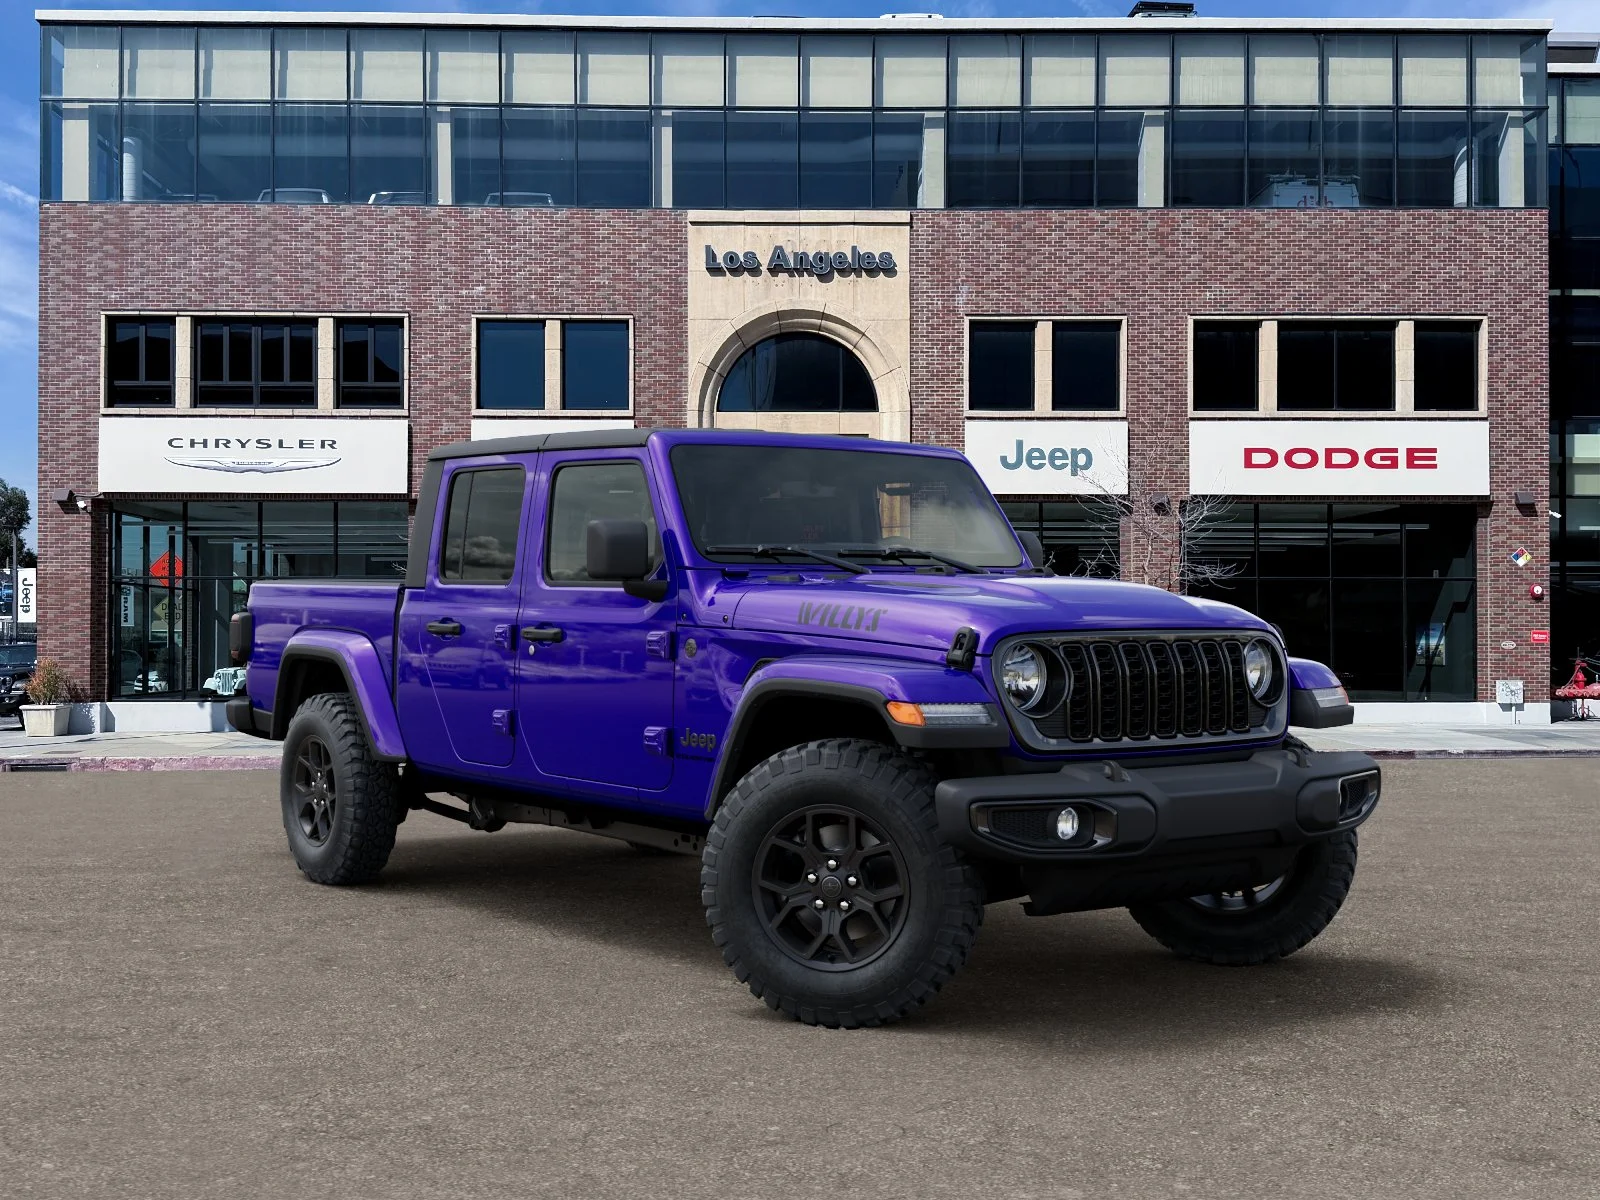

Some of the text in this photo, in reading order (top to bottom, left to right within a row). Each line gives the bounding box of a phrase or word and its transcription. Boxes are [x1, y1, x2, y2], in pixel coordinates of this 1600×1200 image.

[704, 245, 895, 275] Los Angeles
[167, 437, 338, 450] CHRYSLER
[999, 438, 1093, 477] Jeep
[1243, 447, 1438, 470] DODGE
[19, 577, 34, 614] Jeep
[161, 602, 183, 611] DAD
[164, 612, 181, 620] ED
[797, 600, 889, 632] WILLYS
[679, 727, 717, 753] Jeep
